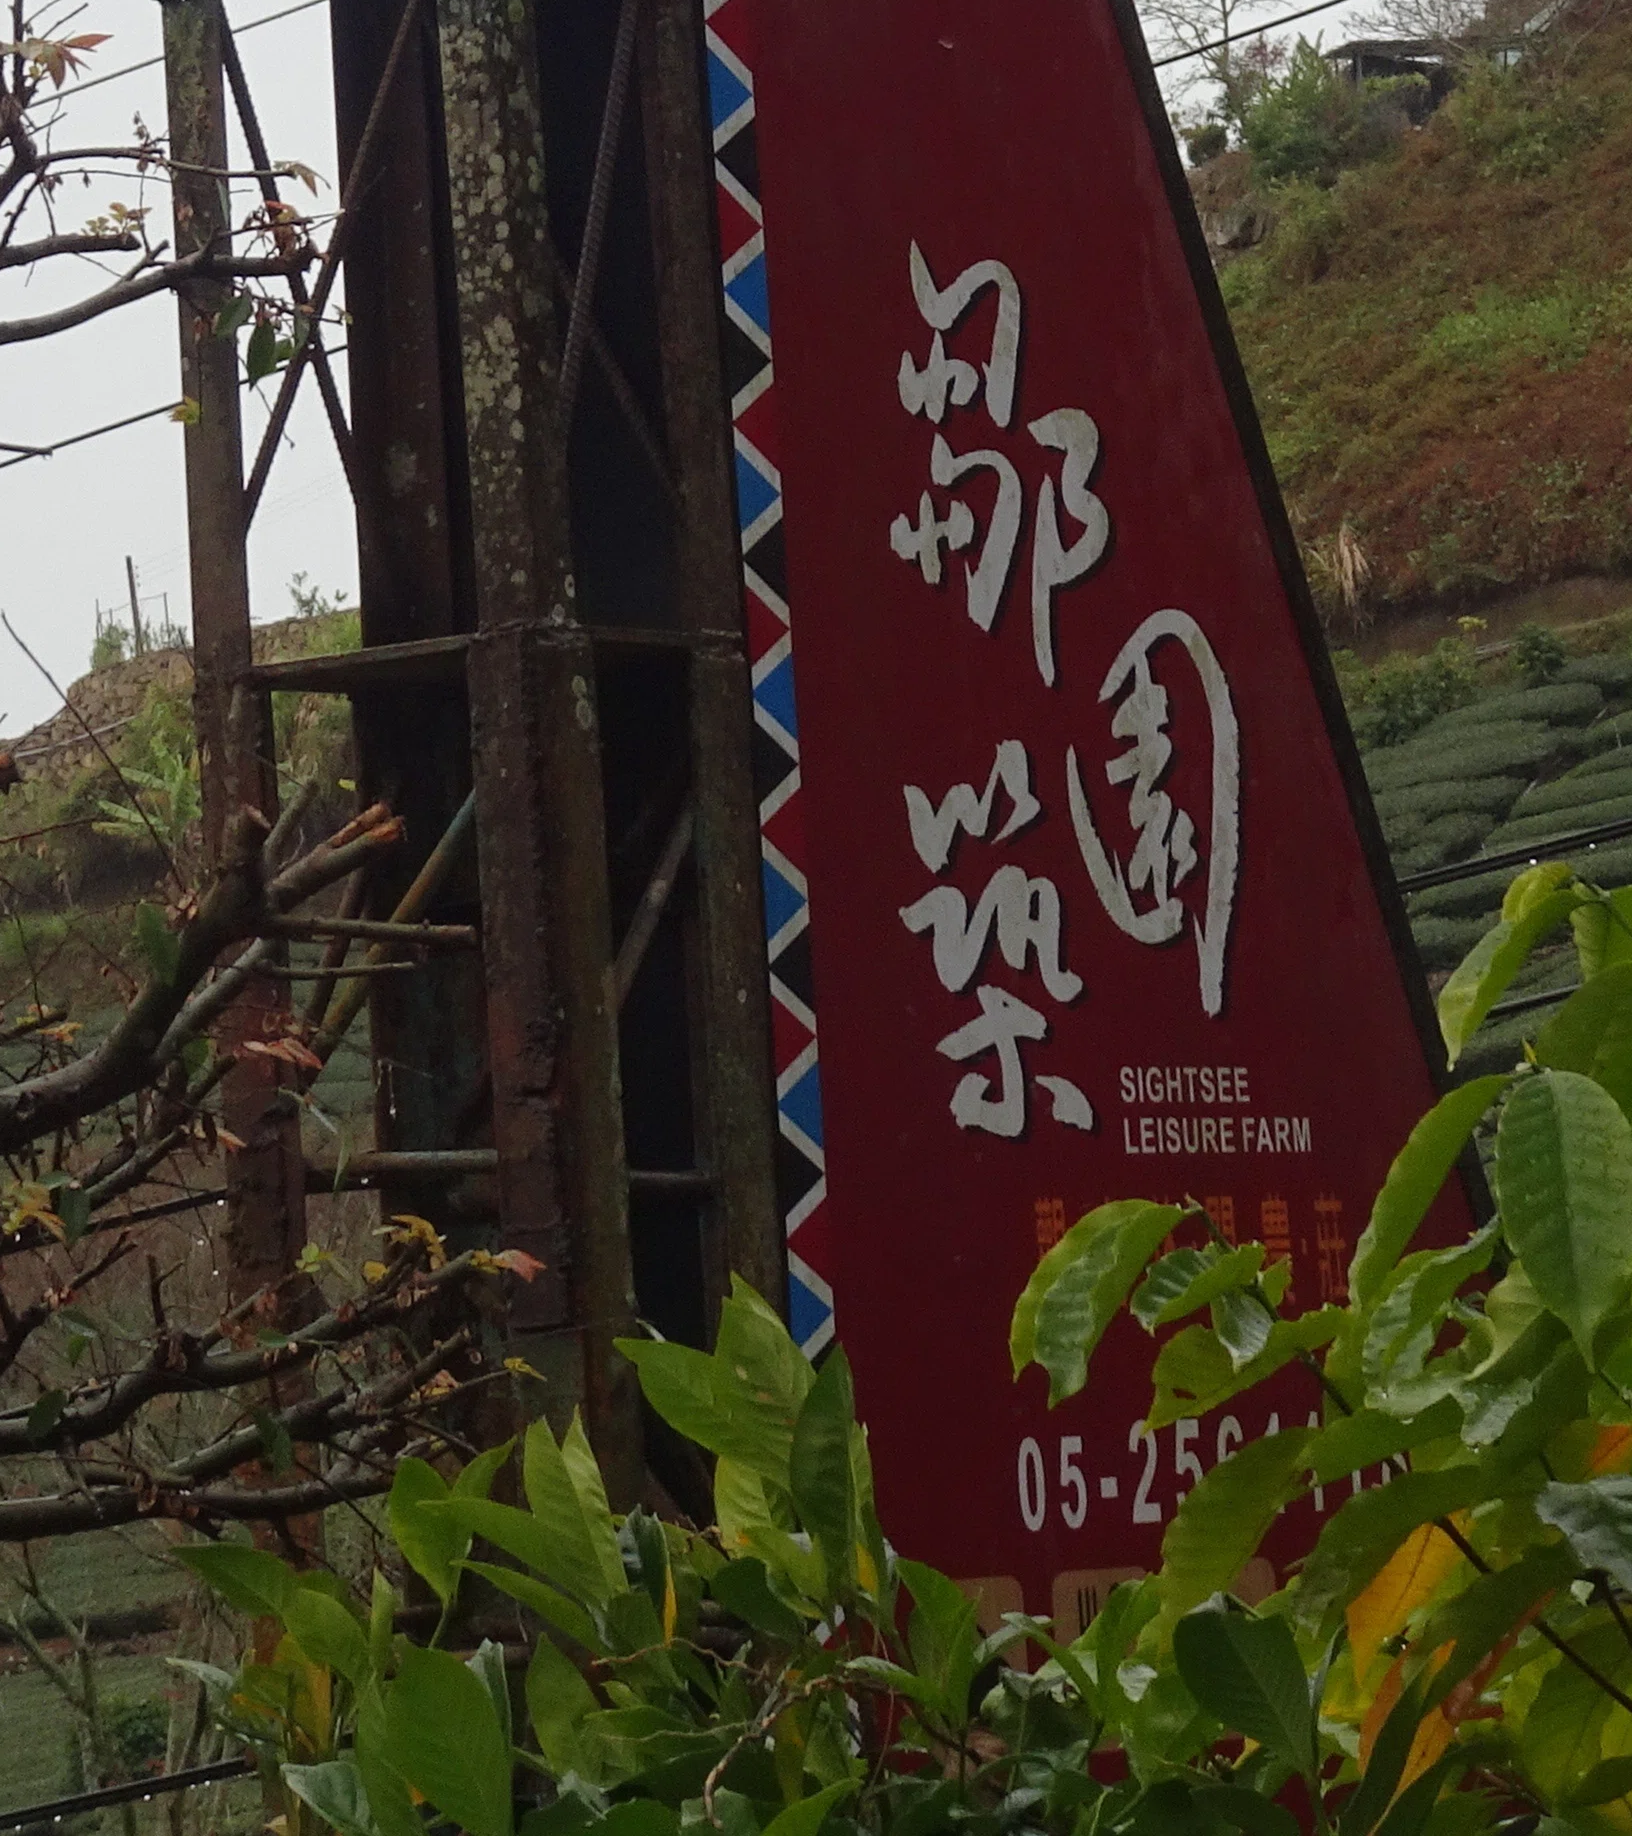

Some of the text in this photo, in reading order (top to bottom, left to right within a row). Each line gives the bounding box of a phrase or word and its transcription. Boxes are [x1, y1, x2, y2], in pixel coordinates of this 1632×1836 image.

[1120, 1066, 1251, 1103] SIGHTSEE
[1123, 1117, 1312, 1154] LEISURE FARM
